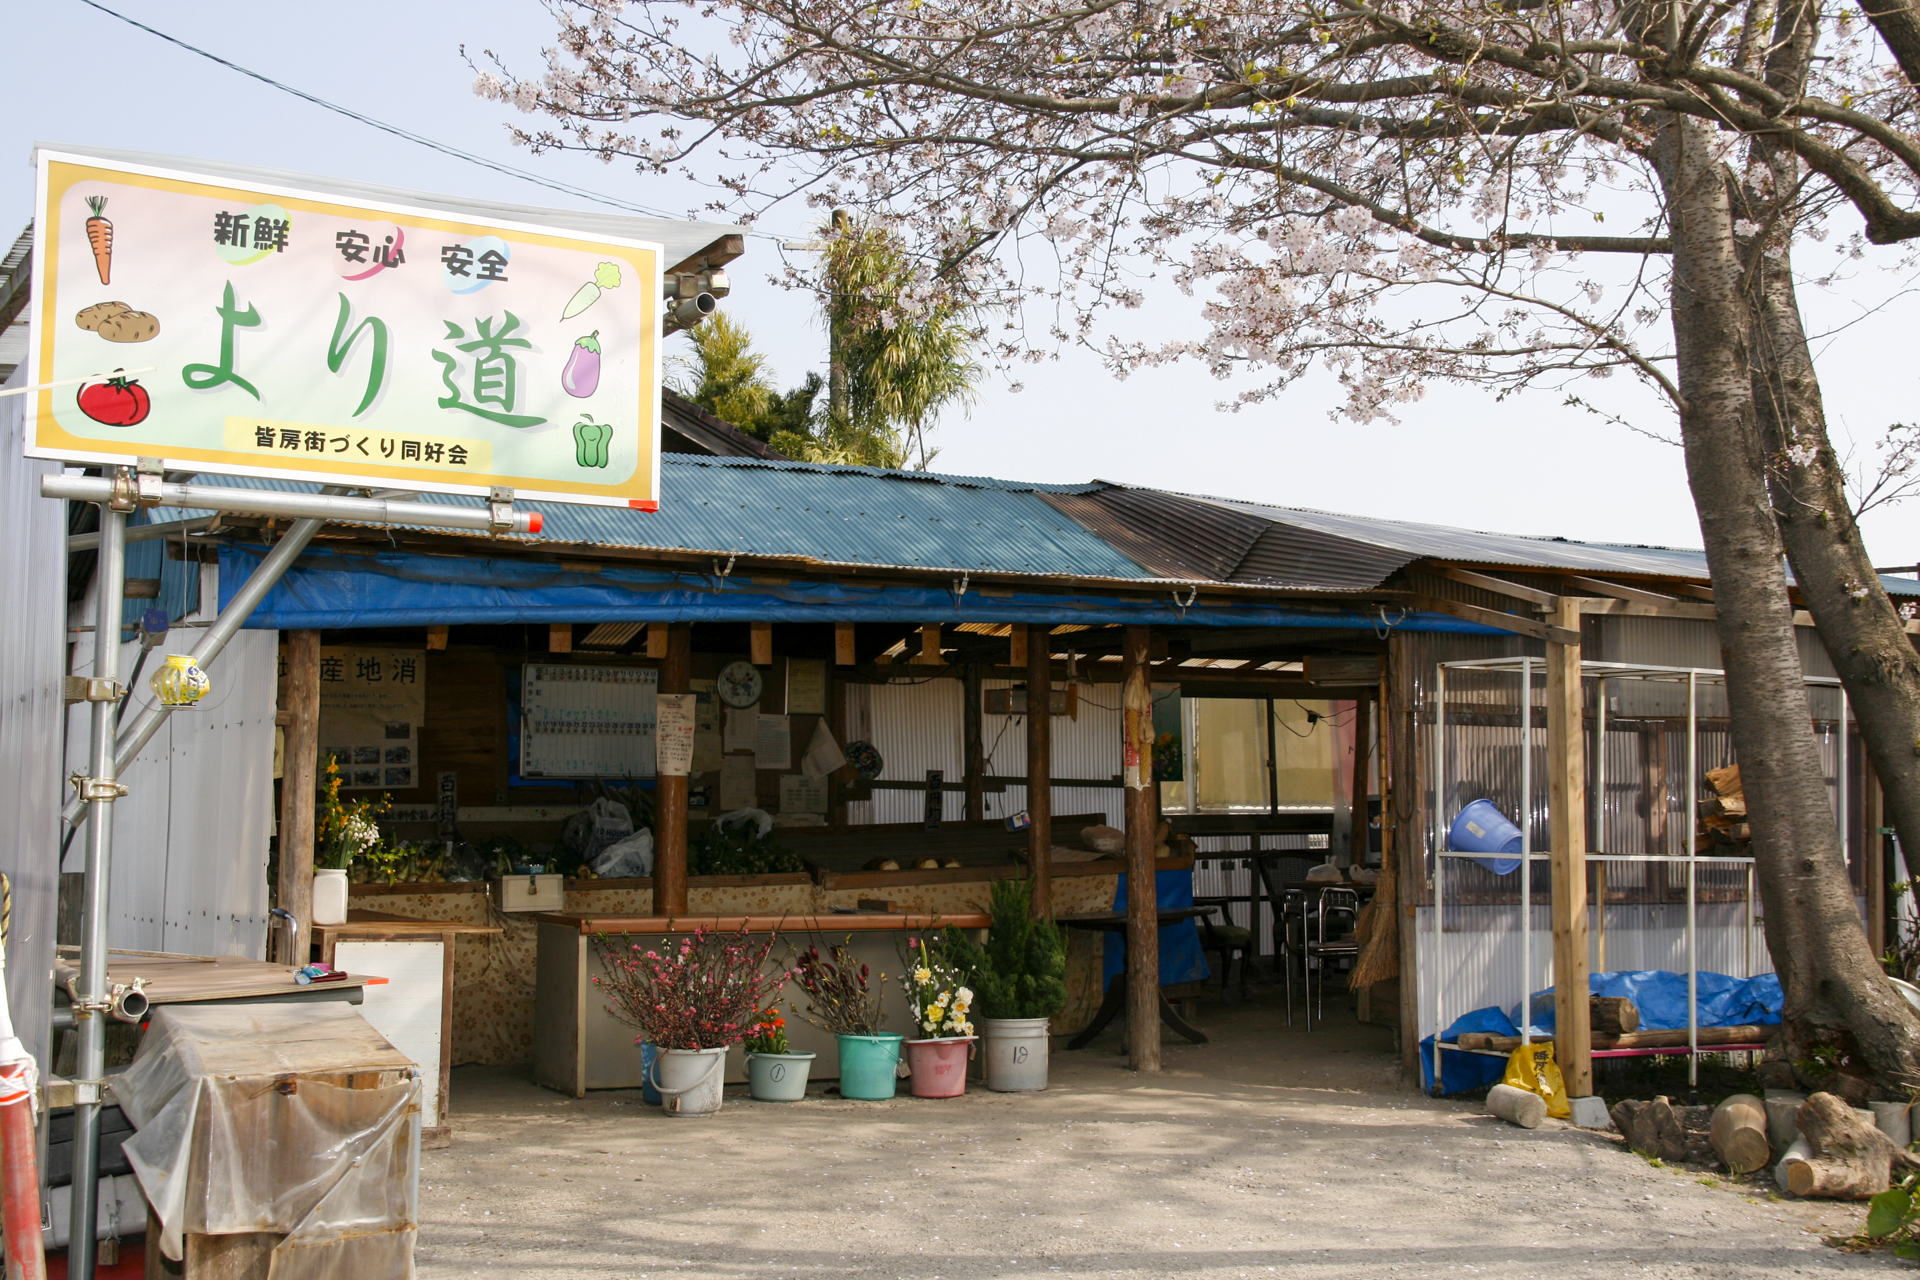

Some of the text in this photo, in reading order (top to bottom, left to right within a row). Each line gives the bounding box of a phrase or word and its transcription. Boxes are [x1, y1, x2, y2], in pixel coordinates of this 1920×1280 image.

[214, 210, 509, 282] 新鮮 安心 安全
[182, 279, 548, 428] より道
[254, 425, 468, 465] 皆房街づくり同好会
[439, 773, 456, 836] 百円均一
[927, 773, 942, 830] 百円均一
[606, 829, 631, 837] HOUSE
